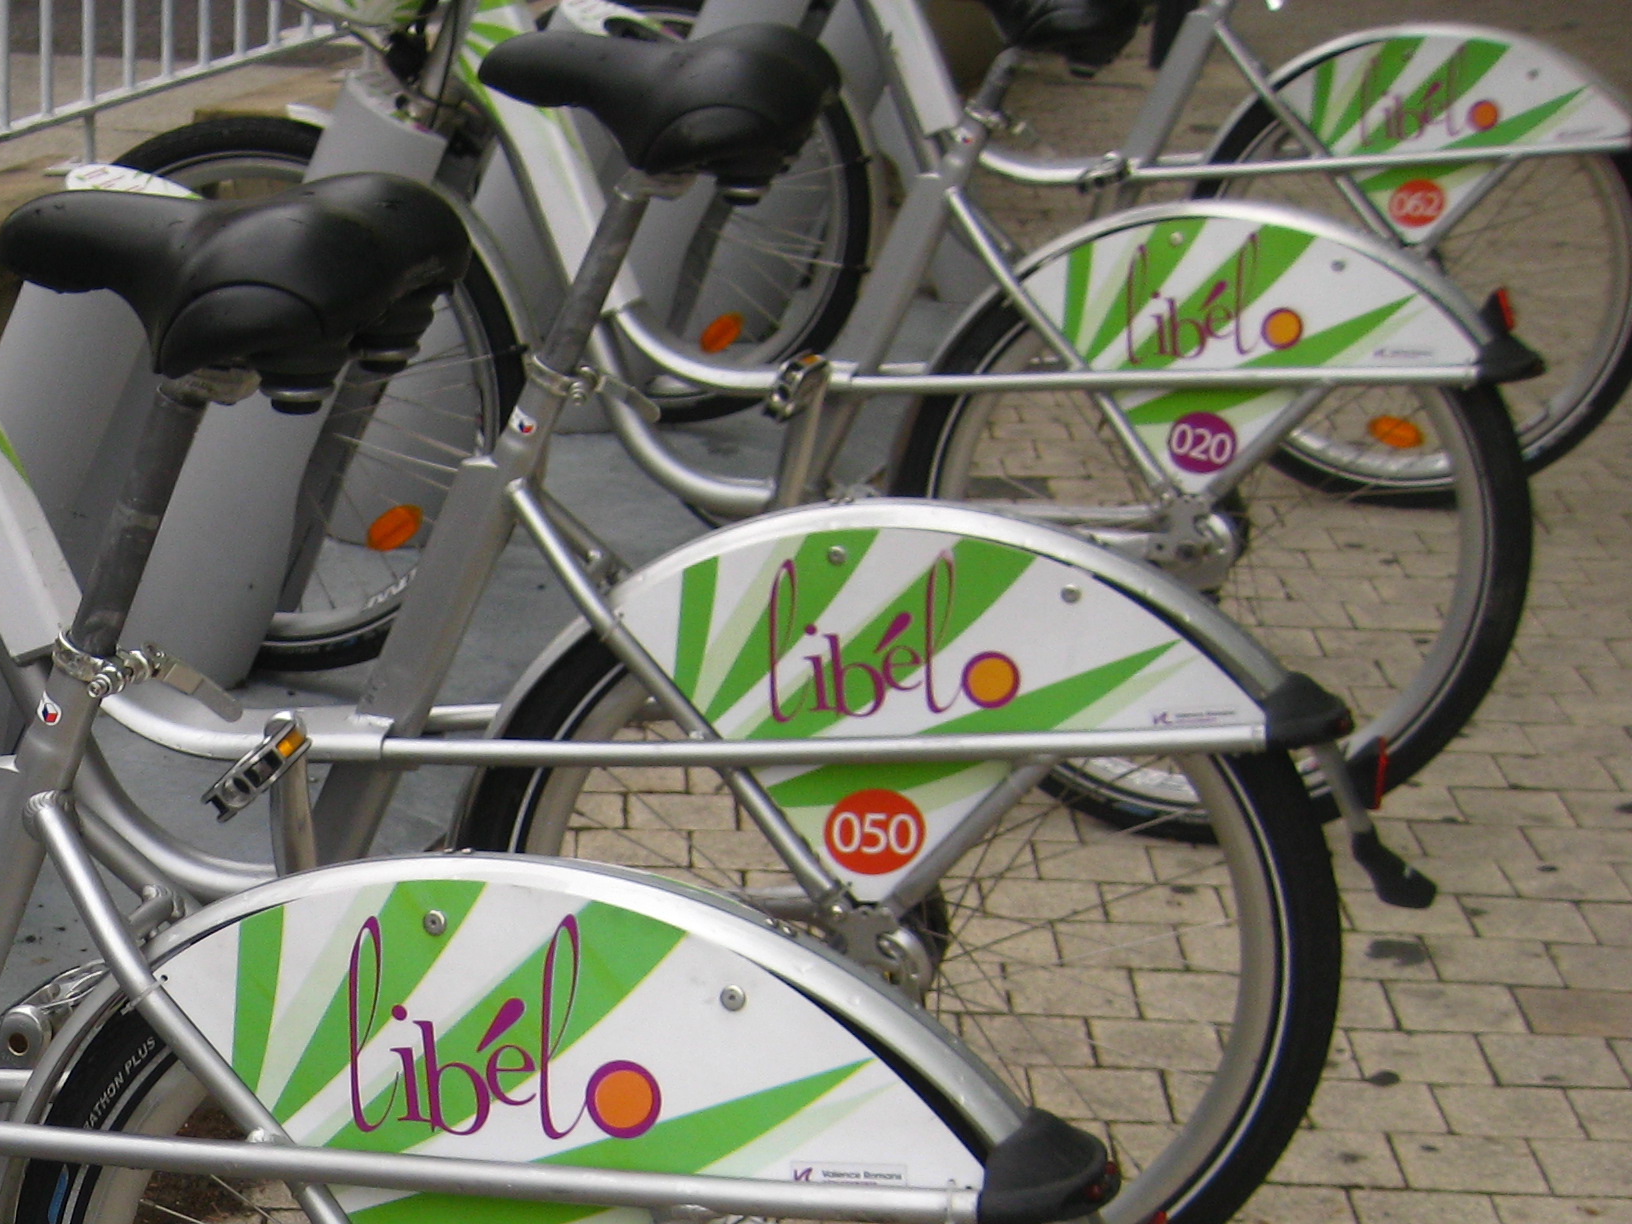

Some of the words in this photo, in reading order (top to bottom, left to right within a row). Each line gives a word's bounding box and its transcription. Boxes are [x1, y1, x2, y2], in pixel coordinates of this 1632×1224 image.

[1388, 188, 1443, 219] 062
[1124, 232, 1304, 366] libélo
[1170, 421, 1233, 465] 020
[768, 549, 1021, 723] libélo
[832, 811, 919, 856] 050
[347, 913, 661, 1140] libélo
[124, 1036, 157, 1076] PLUS
